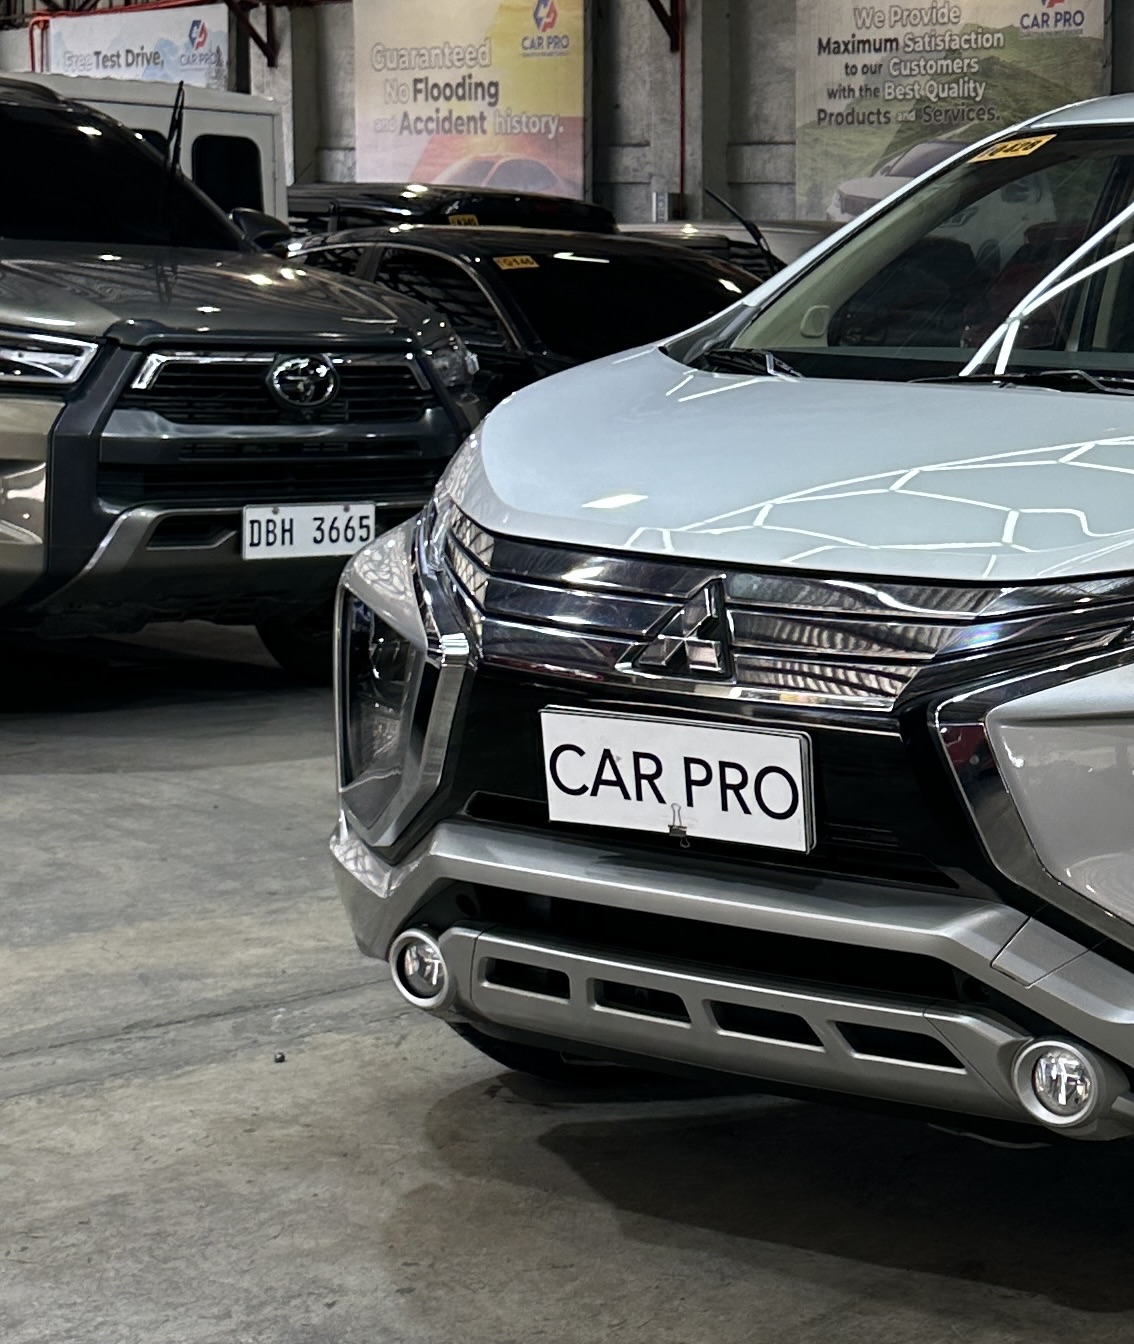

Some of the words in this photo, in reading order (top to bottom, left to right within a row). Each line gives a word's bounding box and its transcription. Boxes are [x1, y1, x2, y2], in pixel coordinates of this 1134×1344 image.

[853, 6, 885, 30] We
[889, 0, 961, 29] Provide
[1020, 12, 1050, 30] CAR
[1054, 9, 1085, 28] PRO
[371, 37, 492, 72] Guaranteed
[521, 35, 544, 51] CAR
[546, 34, 570, 50] PRO
[817, 34, 900, 56] Maximum
[903, 29, 1005, 54] Satisfaction
[94, 51, 121, 69] Test
[125, 45, 165, 69] Drive,
[844, 62, 858, 77] to
[861, 64, 883, 77] our
[889, 56, 980, 77] Customers
[383, 78, 411, 105] No
[412, 73, 500, 107] Flooding
[827, 82, 856, 100] with
[858, 82, 880, 99] the
[884, 79, 921, 100] Best
[925, 79, 986, 102] Quality
[374, 113, 397, 134] and
[399, 107, 487, 136] Accident
[493, 107, 565, 140] history.
[817, 107, 891, 126] Products
[896, 108, 916, 122] and
[922, 103, 1001, 124] Services.
[249, 518, 293, 547] DBH
[313, 515, 370, 544] 3665
[549, 743, 667, 804] CAR
[683, 756, 799, 820] PRO
